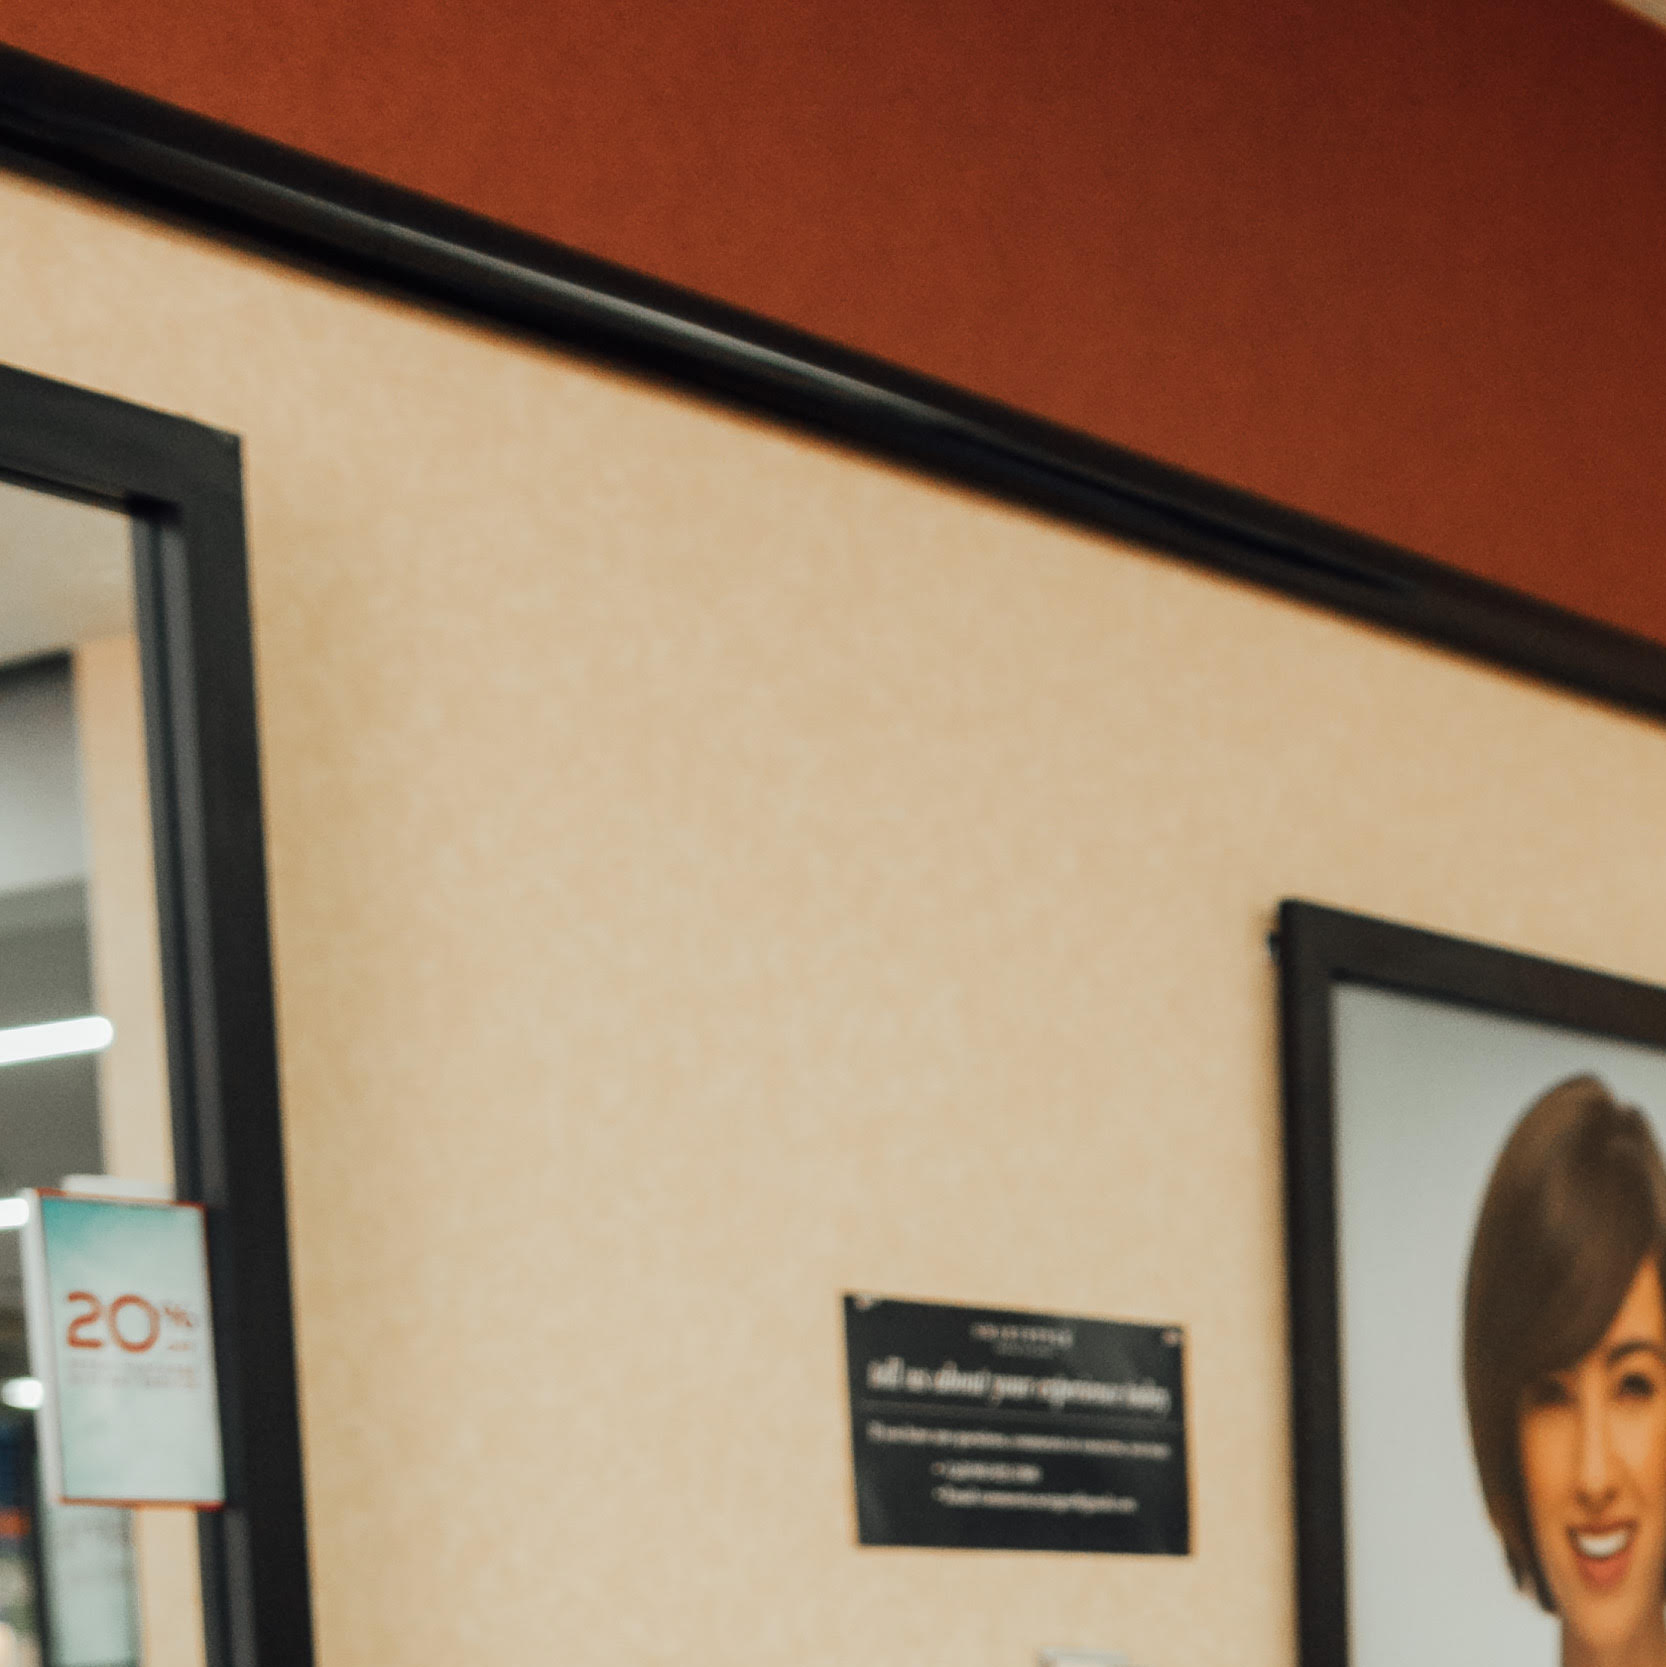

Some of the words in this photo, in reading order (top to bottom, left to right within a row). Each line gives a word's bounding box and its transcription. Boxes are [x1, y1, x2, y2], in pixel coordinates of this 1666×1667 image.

[65, 1290, 195, 1354] 20%
[933, 1360, 991, 1396] about
[989, 1372, 1035, 1408] your
